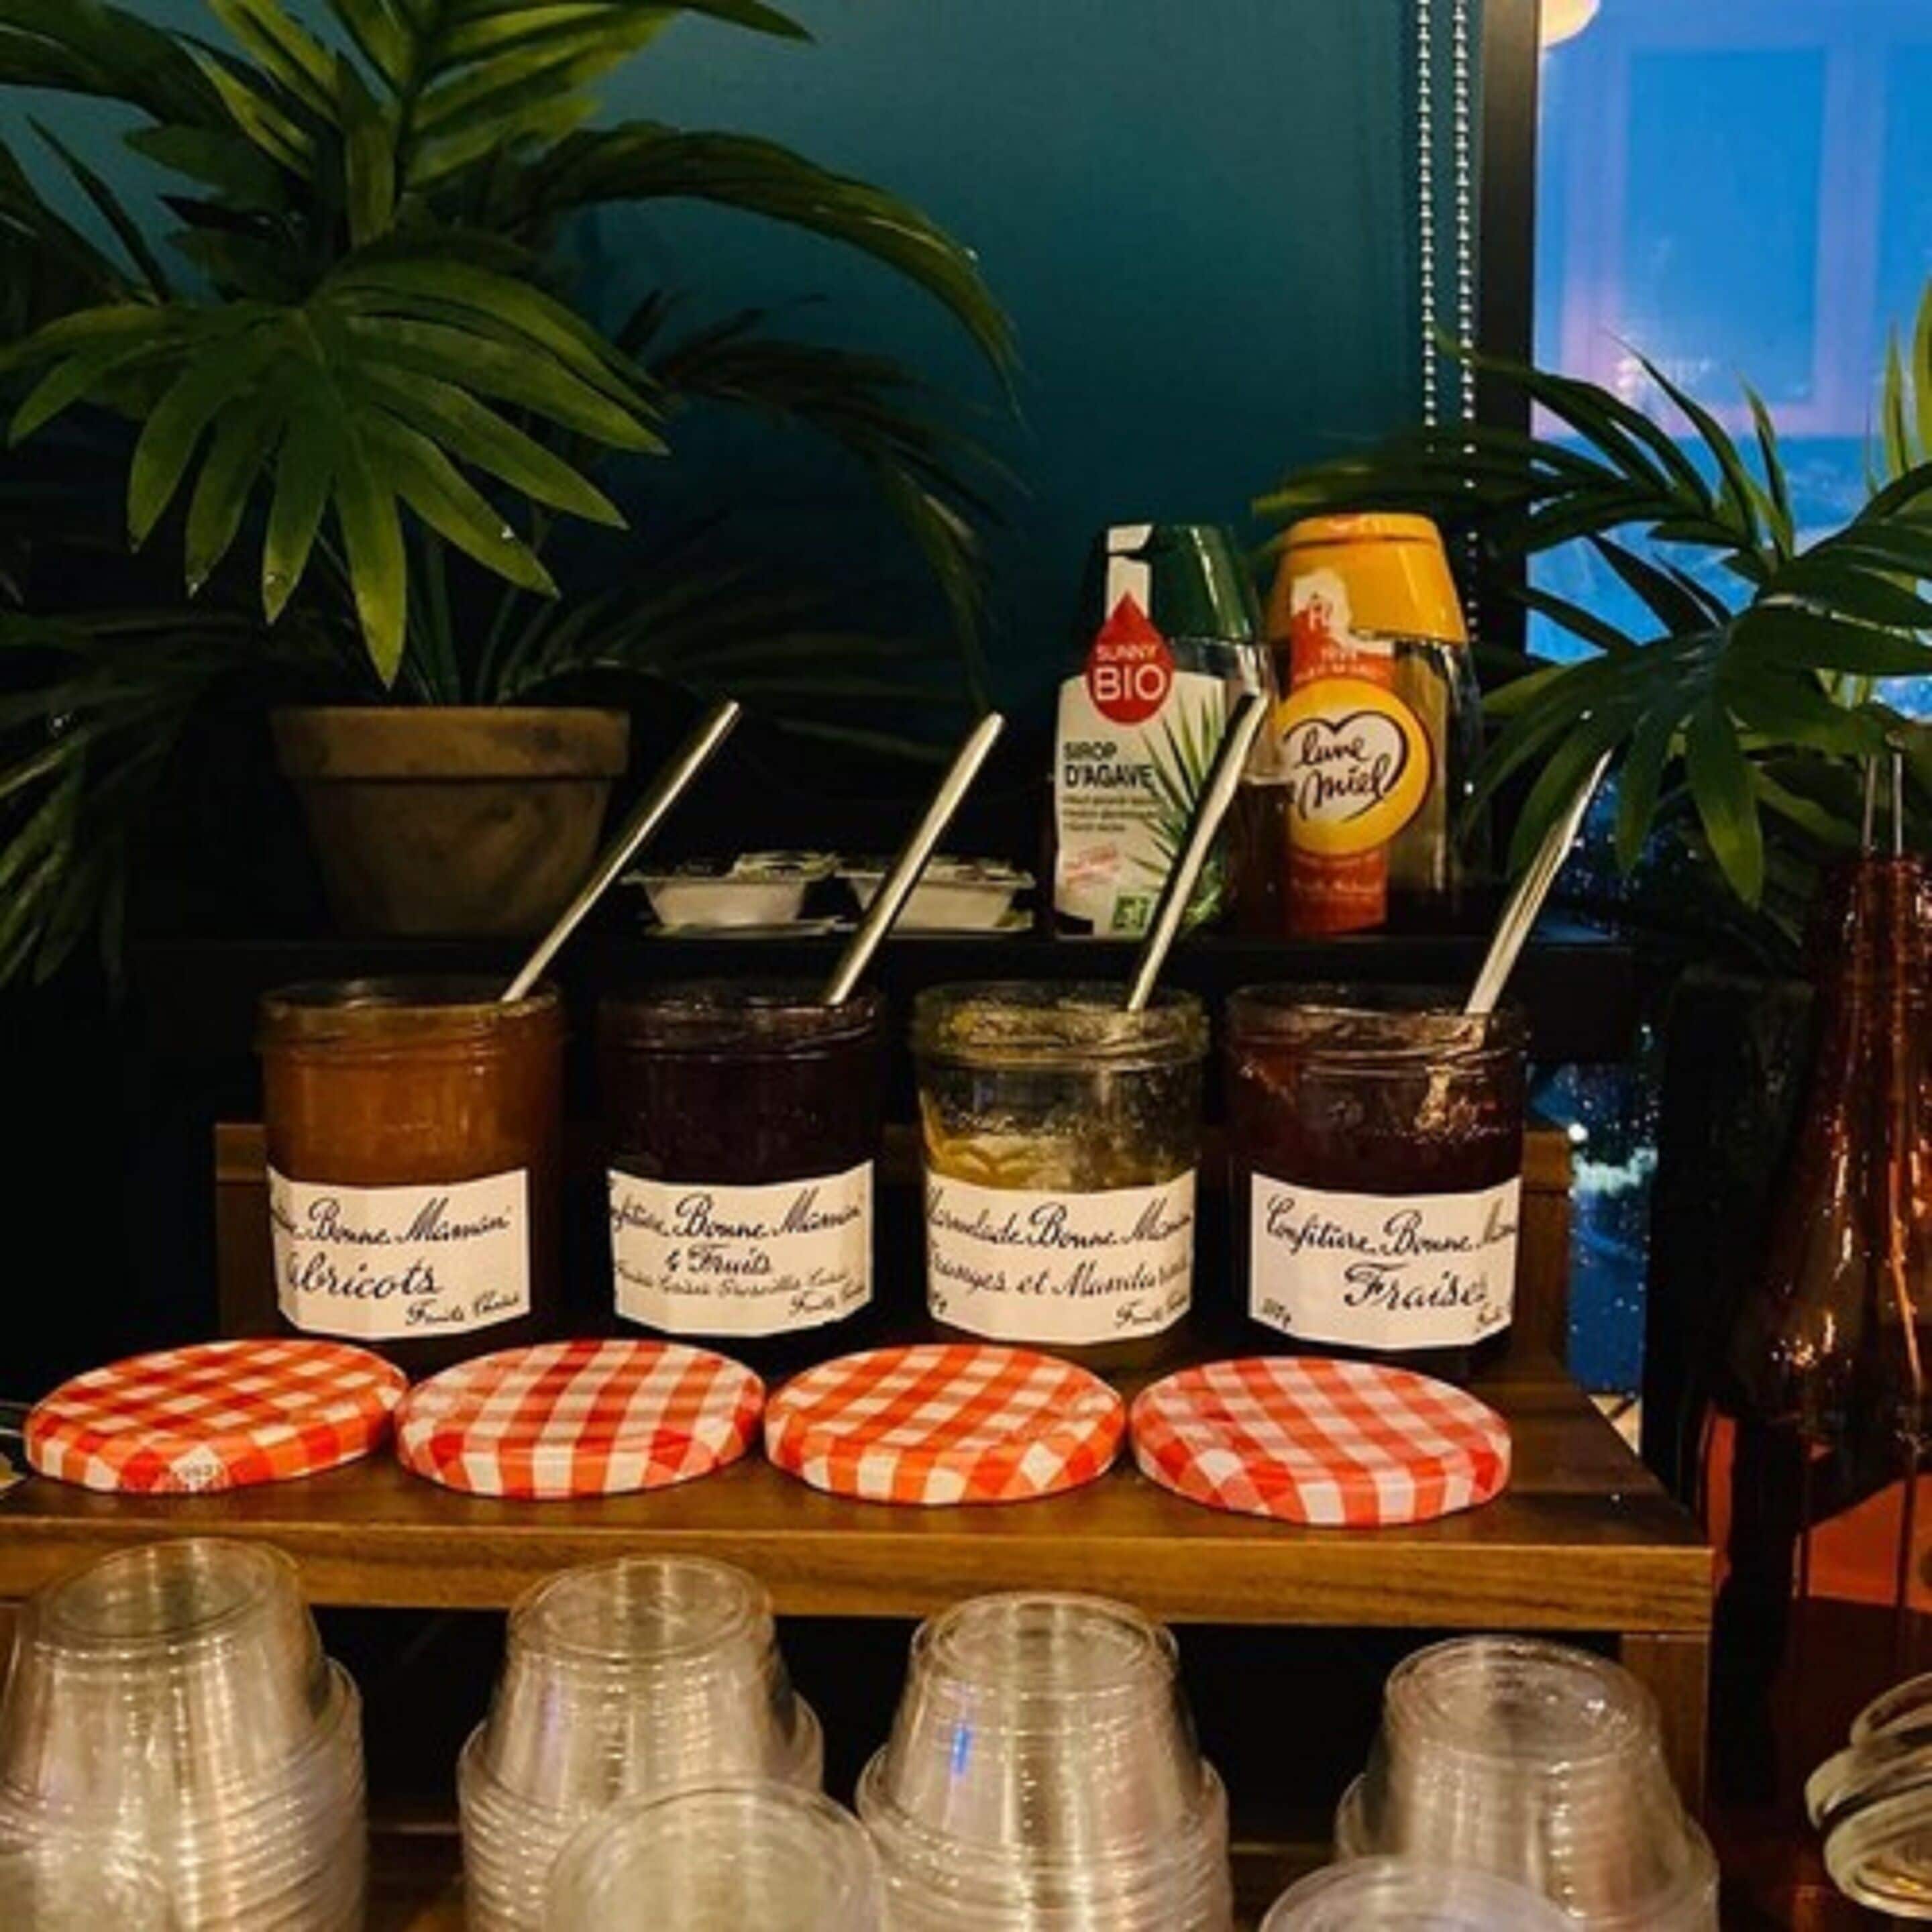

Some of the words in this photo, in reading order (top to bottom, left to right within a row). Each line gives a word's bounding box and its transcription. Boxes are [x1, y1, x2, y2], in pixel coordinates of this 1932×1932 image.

[1095, 663, 1166, 701] BIO
[1064, 741, 1117, 761] SIROP
[1065, 764, 1153, 789] D'AGAVE
[1266, 1195, 1375, 1255] Confiture
[1016, 1270, 1048, 1296] et
